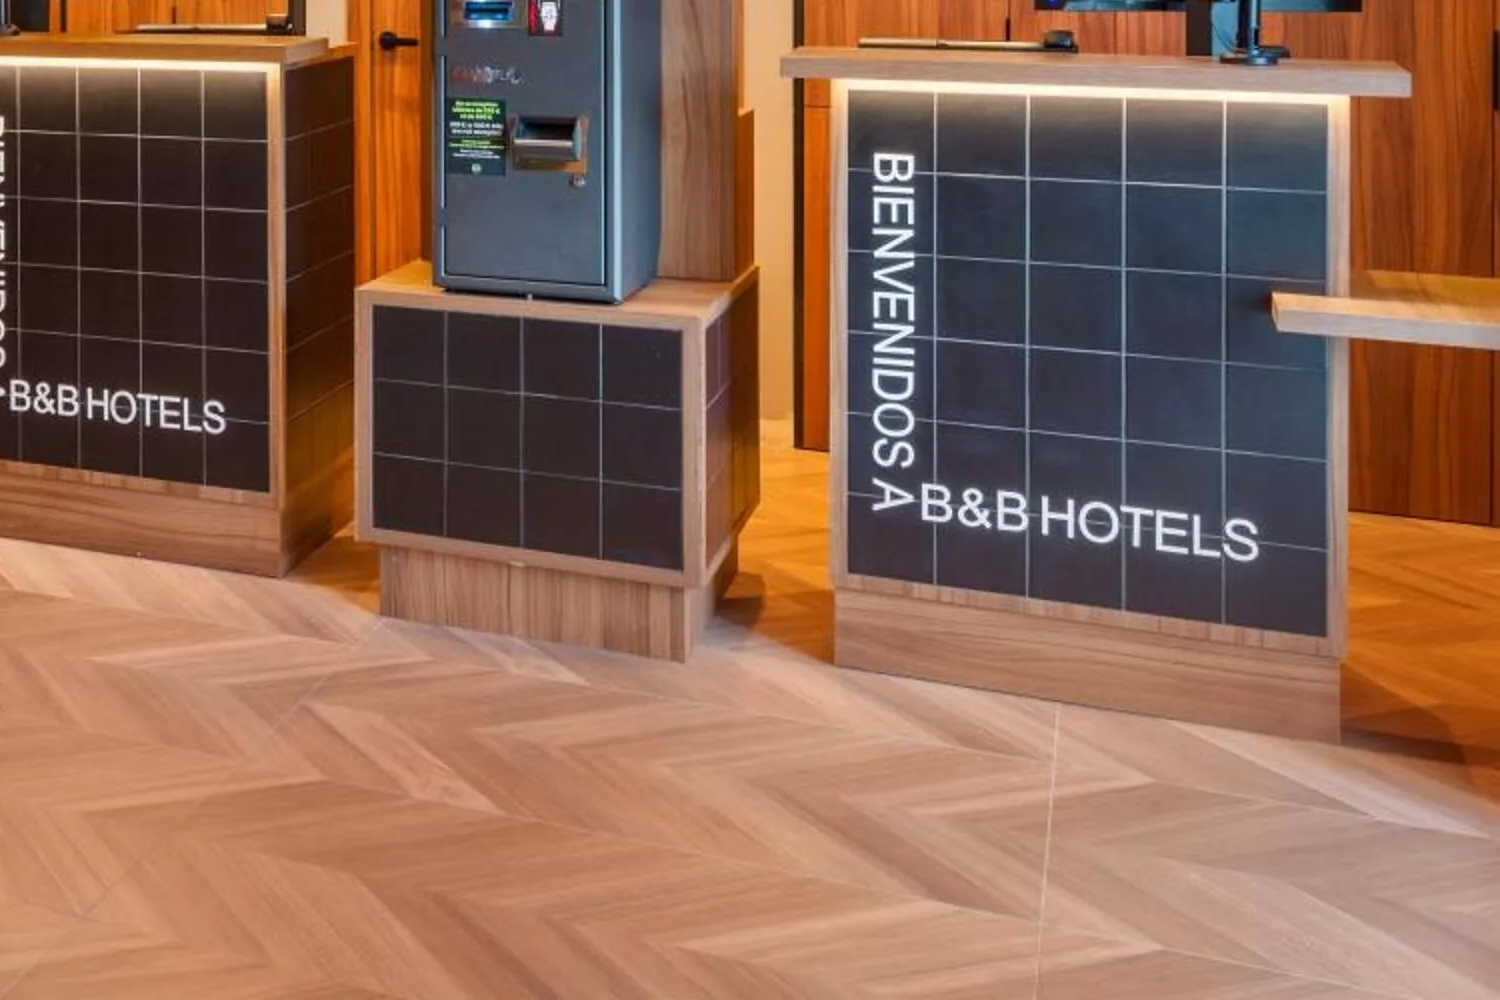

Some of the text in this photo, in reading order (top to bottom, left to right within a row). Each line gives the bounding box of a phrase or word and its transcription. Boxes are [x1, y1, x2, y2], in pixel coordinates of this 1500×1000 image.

[871, 151, 916, 512] BIENVENIDOS A
[8, 378, 228, 437] B&B HOTELS
[920, 481, 1261, 563] B&B HOTELS
